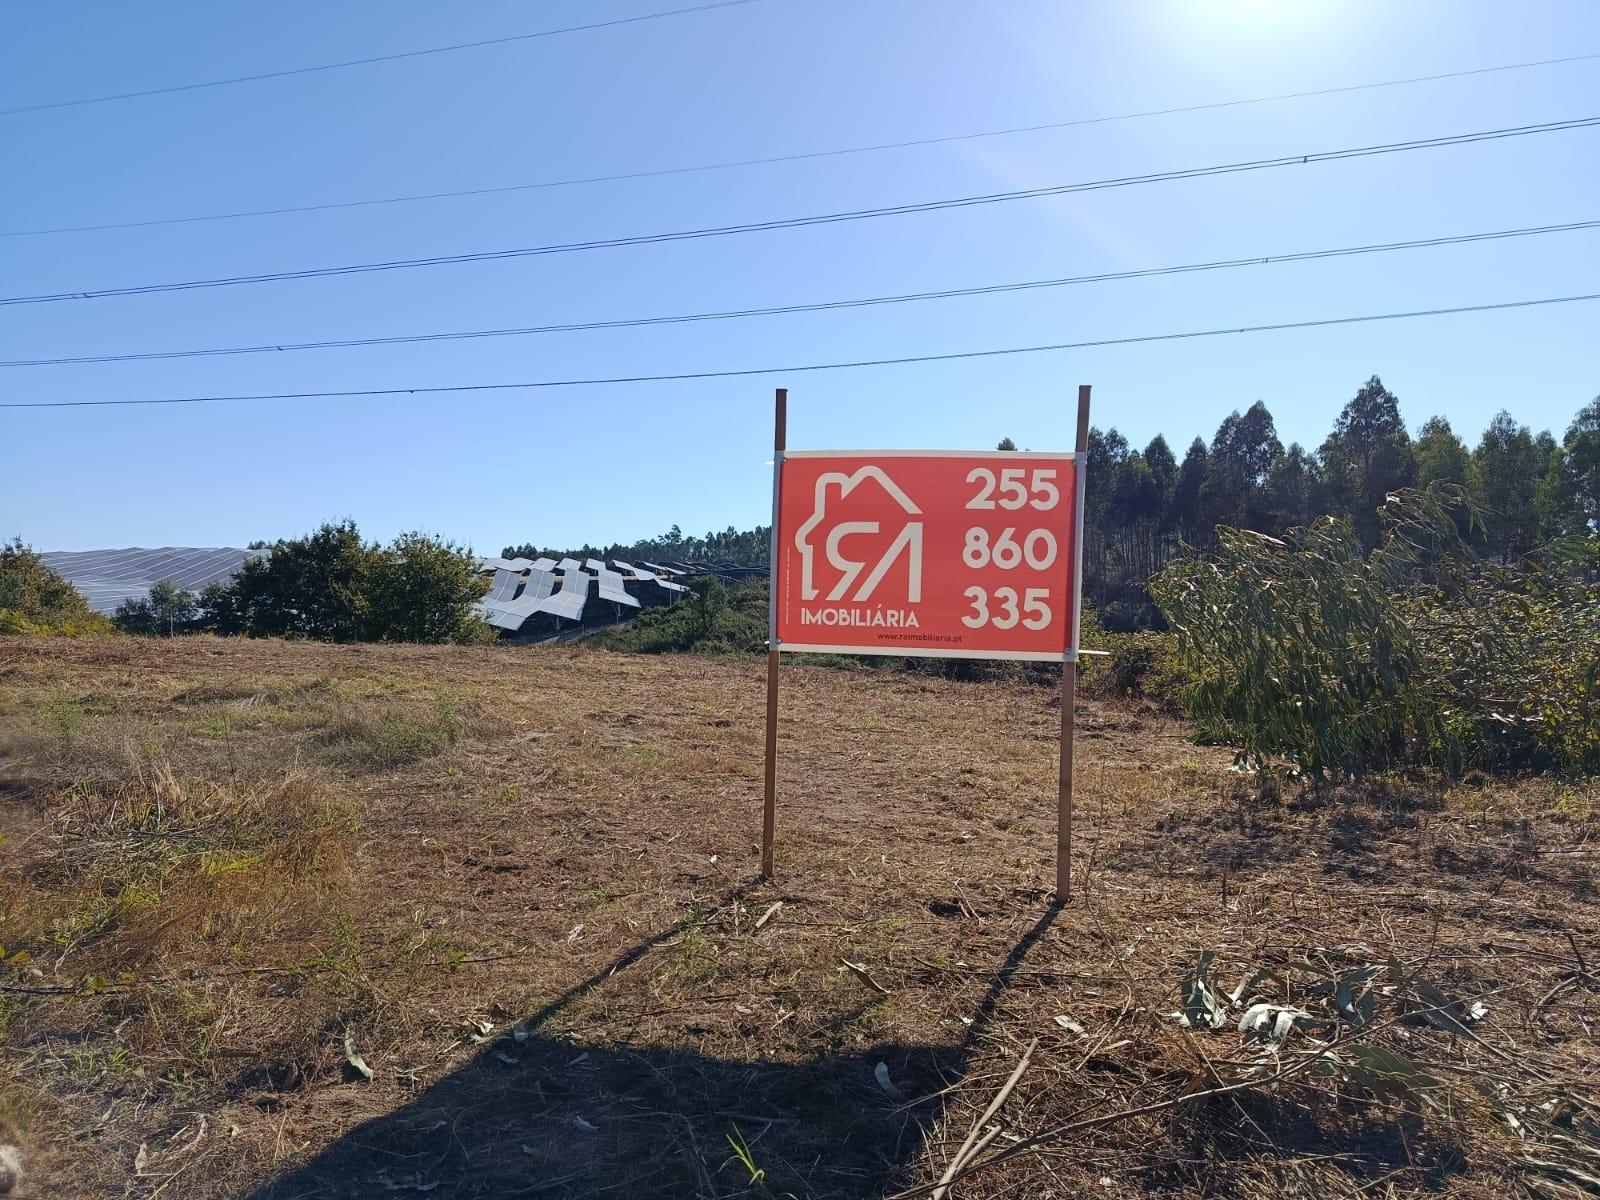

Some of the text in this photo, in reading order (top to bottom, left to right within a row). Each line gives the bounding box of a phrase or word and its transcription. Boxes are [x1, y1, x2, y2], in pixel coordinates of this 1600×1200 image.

[965, 467, 1060, 511] 255
[962, 526, 1058, 571] 860
[801, 604, 920, 628] IMOBILIÁRIA
[961, 585, 1052, 631] 335
[877, 631, 963, 644] www.raimobiliaria.pt
